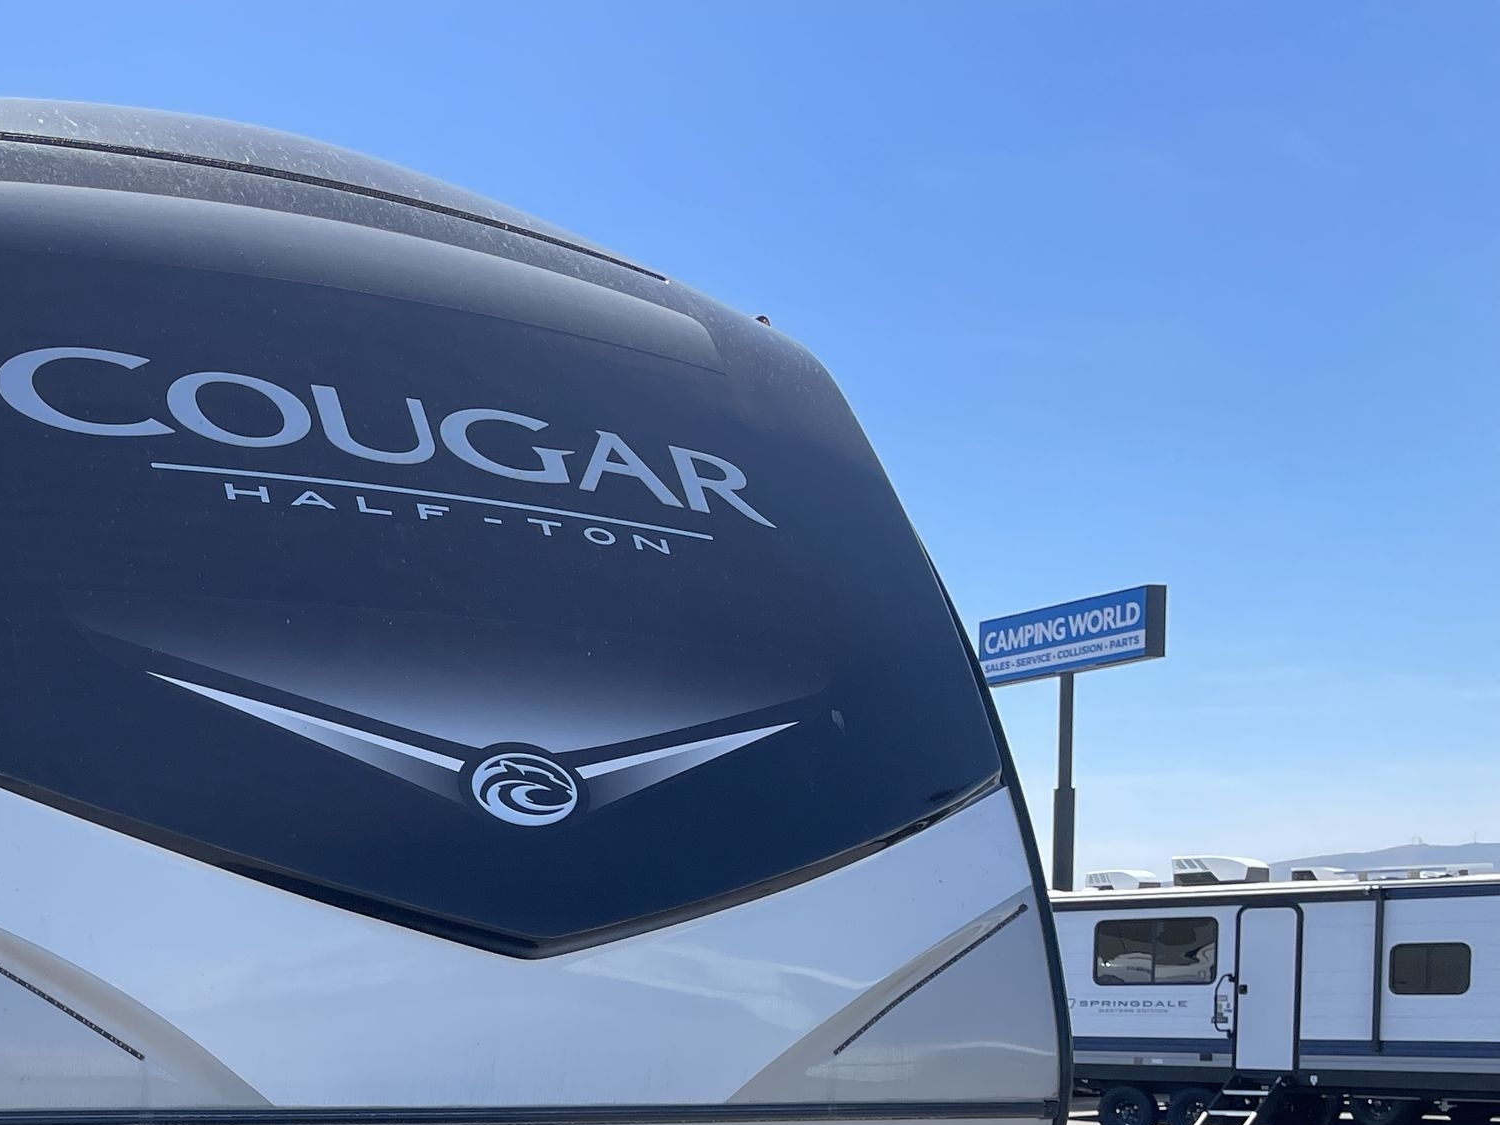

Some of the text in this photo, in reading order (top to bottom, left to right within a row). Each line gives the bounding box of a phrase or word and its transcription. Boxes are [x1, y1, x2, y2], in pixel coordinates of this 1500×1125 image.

[984, 601, 1141, 655] CAMPING WORLD
[984, 635, 1140, 674] SALES SERVICE COLLISION PARTS
[1079, 1000, 1189, 1008] SPRINGDALE
